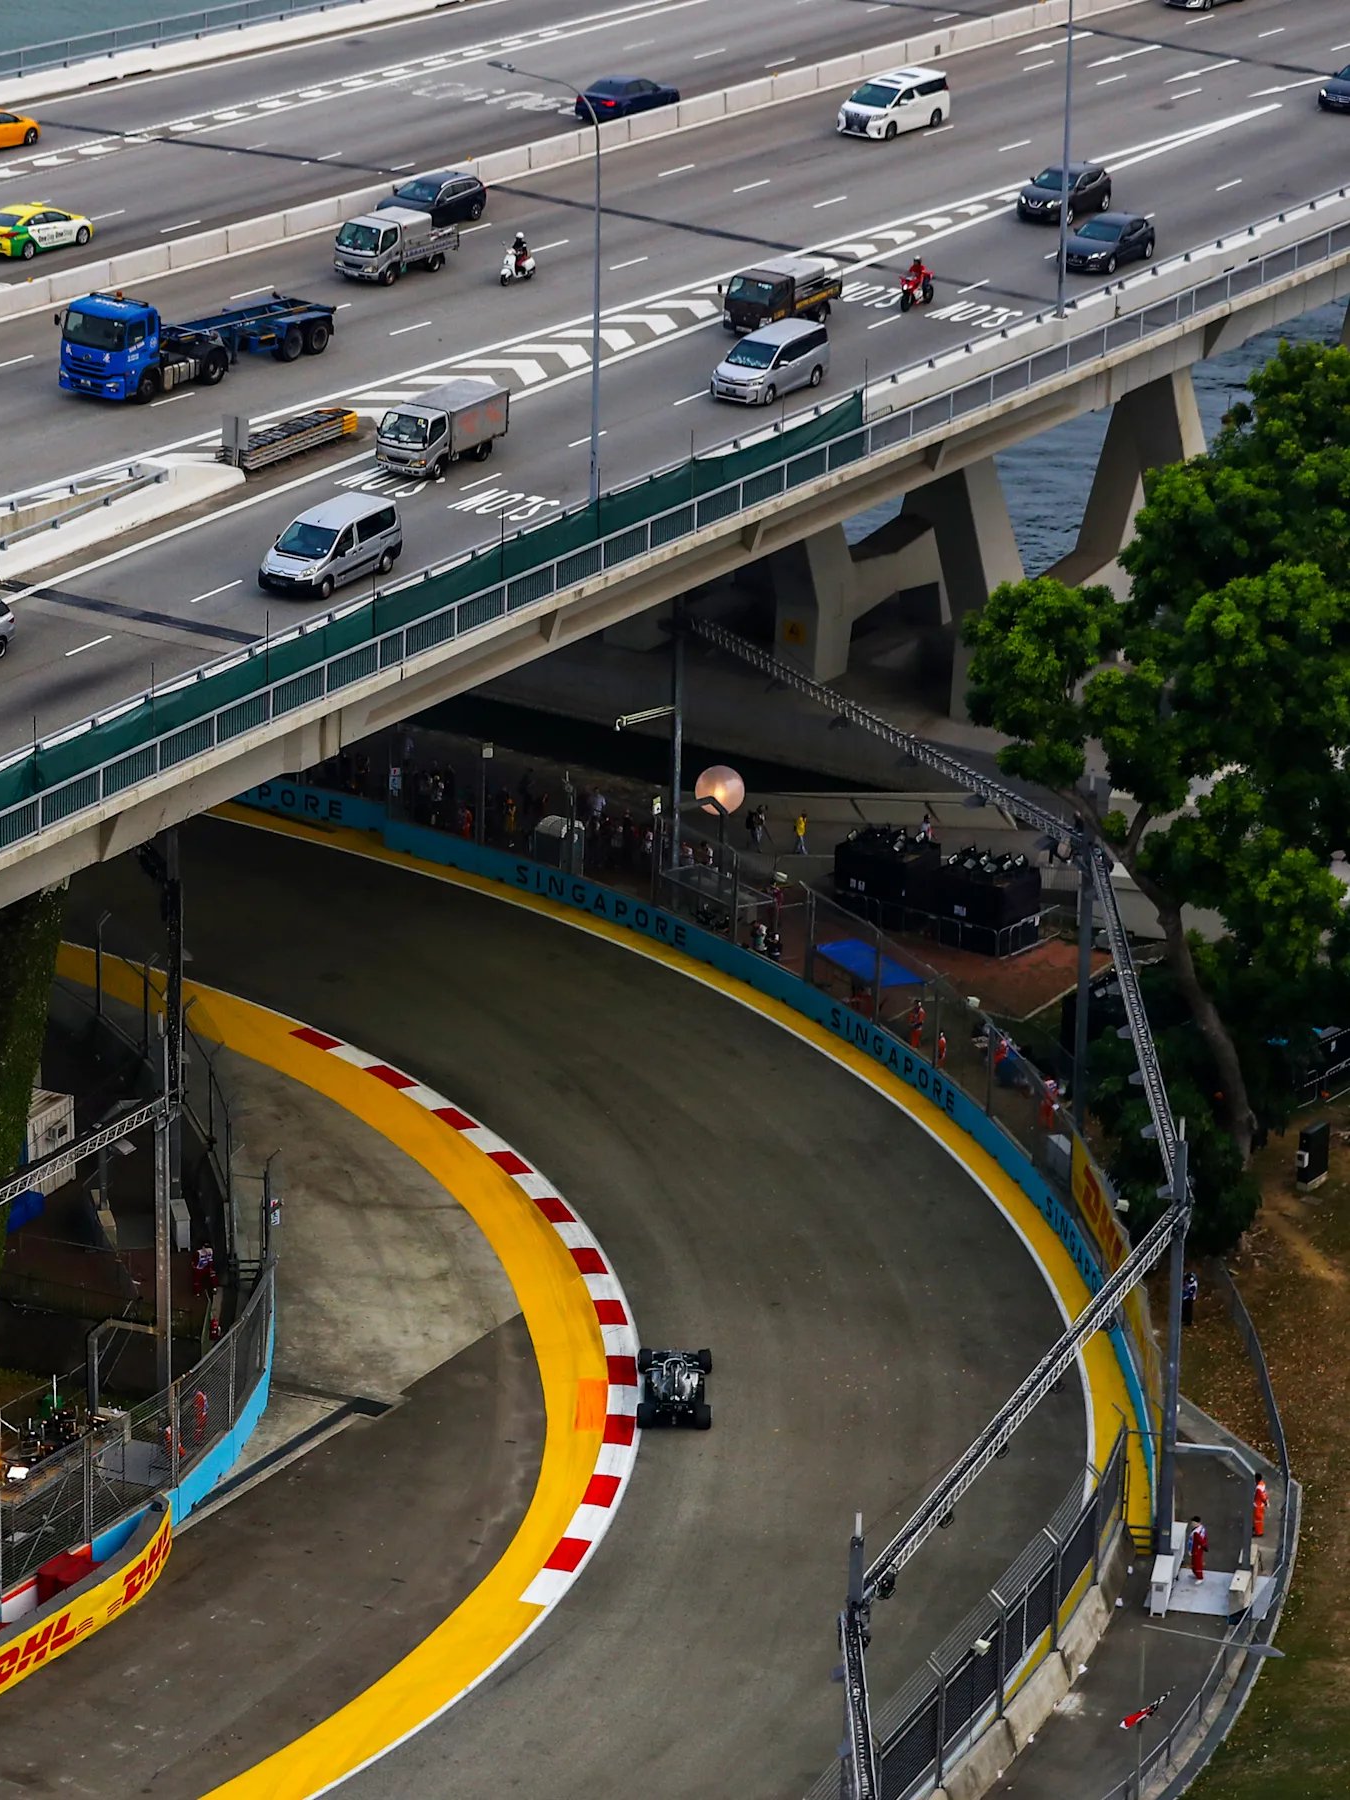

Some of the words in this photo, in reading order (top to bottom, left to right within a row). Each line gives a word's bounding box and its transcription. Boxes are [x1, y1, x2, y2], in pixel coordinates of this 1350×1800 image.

[924, 301, 1024, 329] SLOW
[446, 488, 561, 521] SLOW
[515, 864, 687, 948] SINGAPORE
[830, 1007, 955, 1114] SINGAPORE
[121, 1521, 170, 1606] DHL
